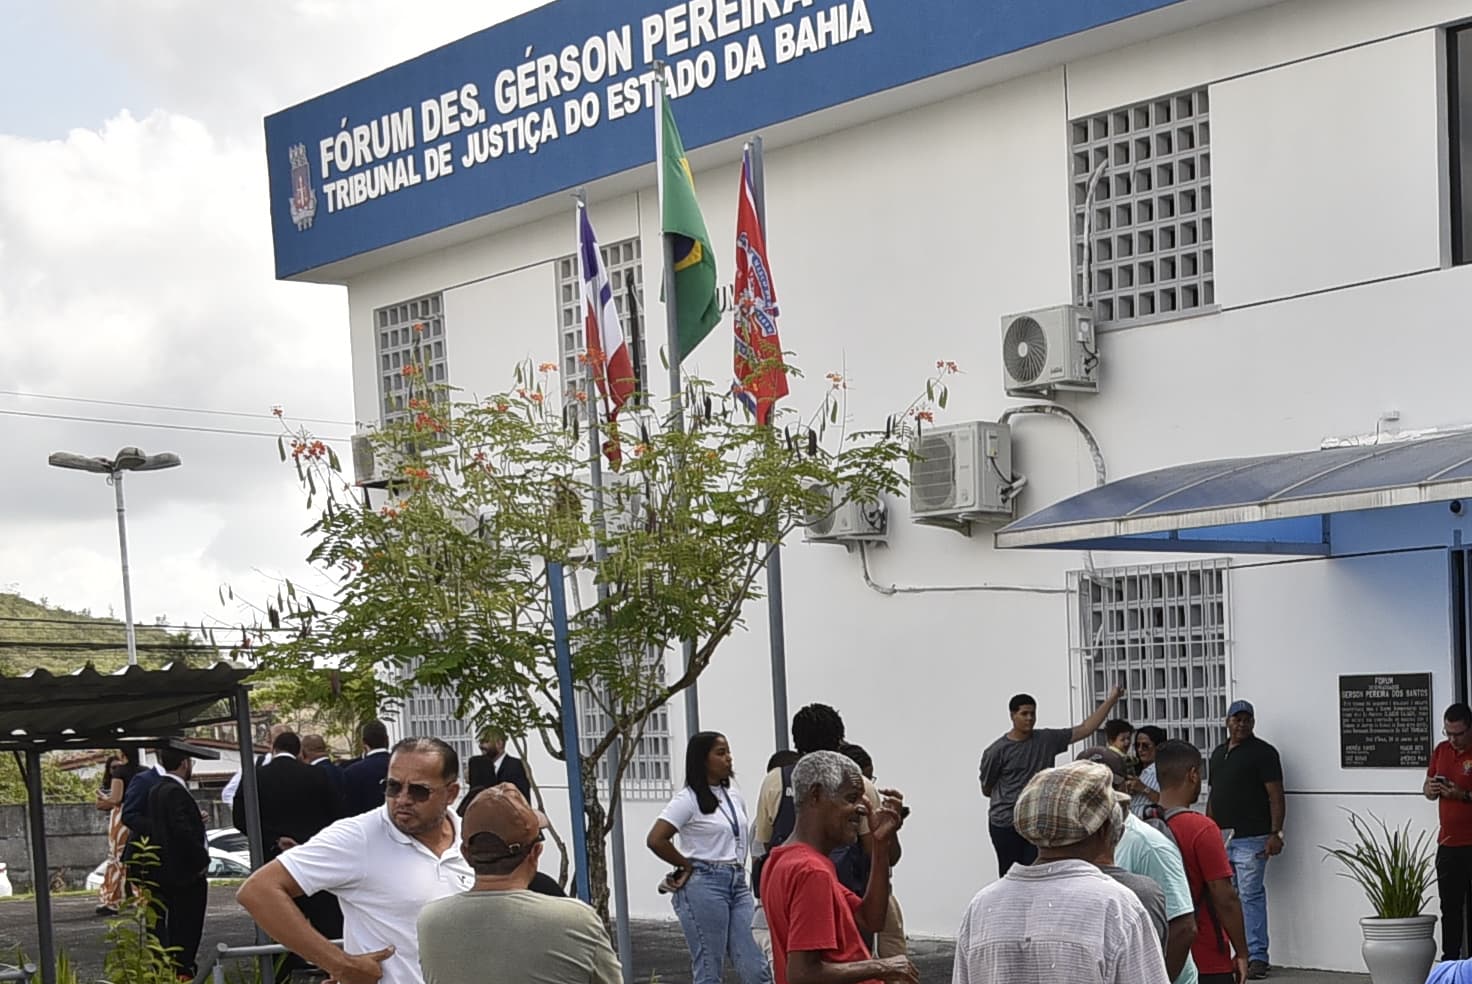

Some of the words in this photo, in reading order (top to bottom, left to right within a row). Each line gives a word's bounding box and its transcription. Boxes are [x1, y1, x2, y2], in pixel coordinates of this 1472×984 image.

[320, 107, 415, 179] FÓRUM
[421, 83, 486, 142] DES.
[494, 24, 632, 114] GÉRSON
[323, 157, 421, 213] TRIBUNAL
[425, 142, 453, 181] DE
[462, 106, 558, 168] JUSTIÇA
[564, 92, 599, 135] DO
[725, 34, 766, 81] DA
[774, 0, 872, 64] BAHIA
